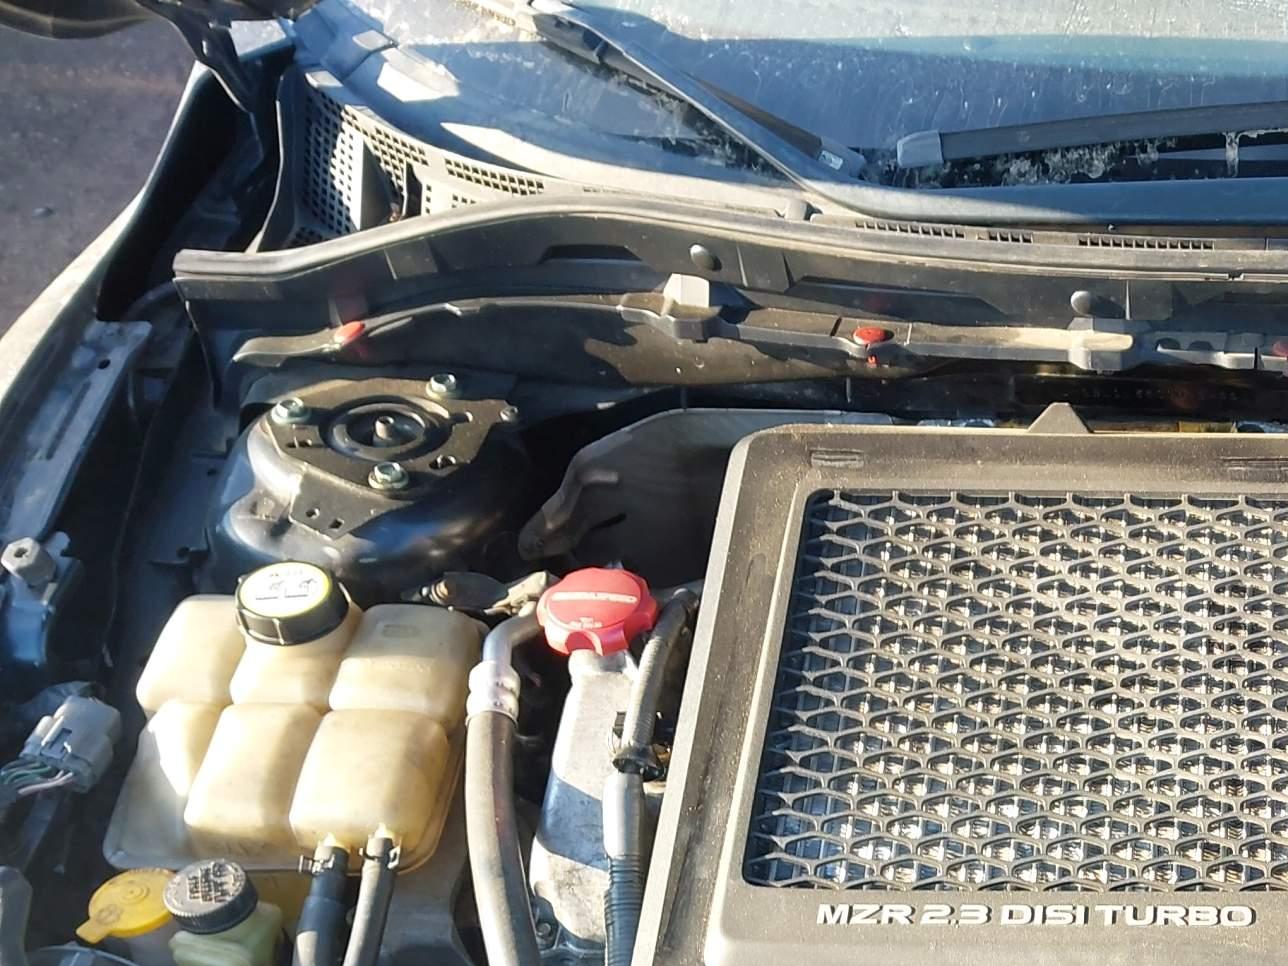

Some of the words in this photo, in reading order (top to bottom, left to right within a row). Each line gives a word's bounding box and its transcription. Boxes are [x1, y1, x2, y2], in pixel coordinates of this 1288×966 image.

[816, 903, 915, 926] MZR
[919, 903, 993, 929] 2.3
[1000, 903, 1089, 926] DISI
[1094, 903, 1257, 927] TURBO
